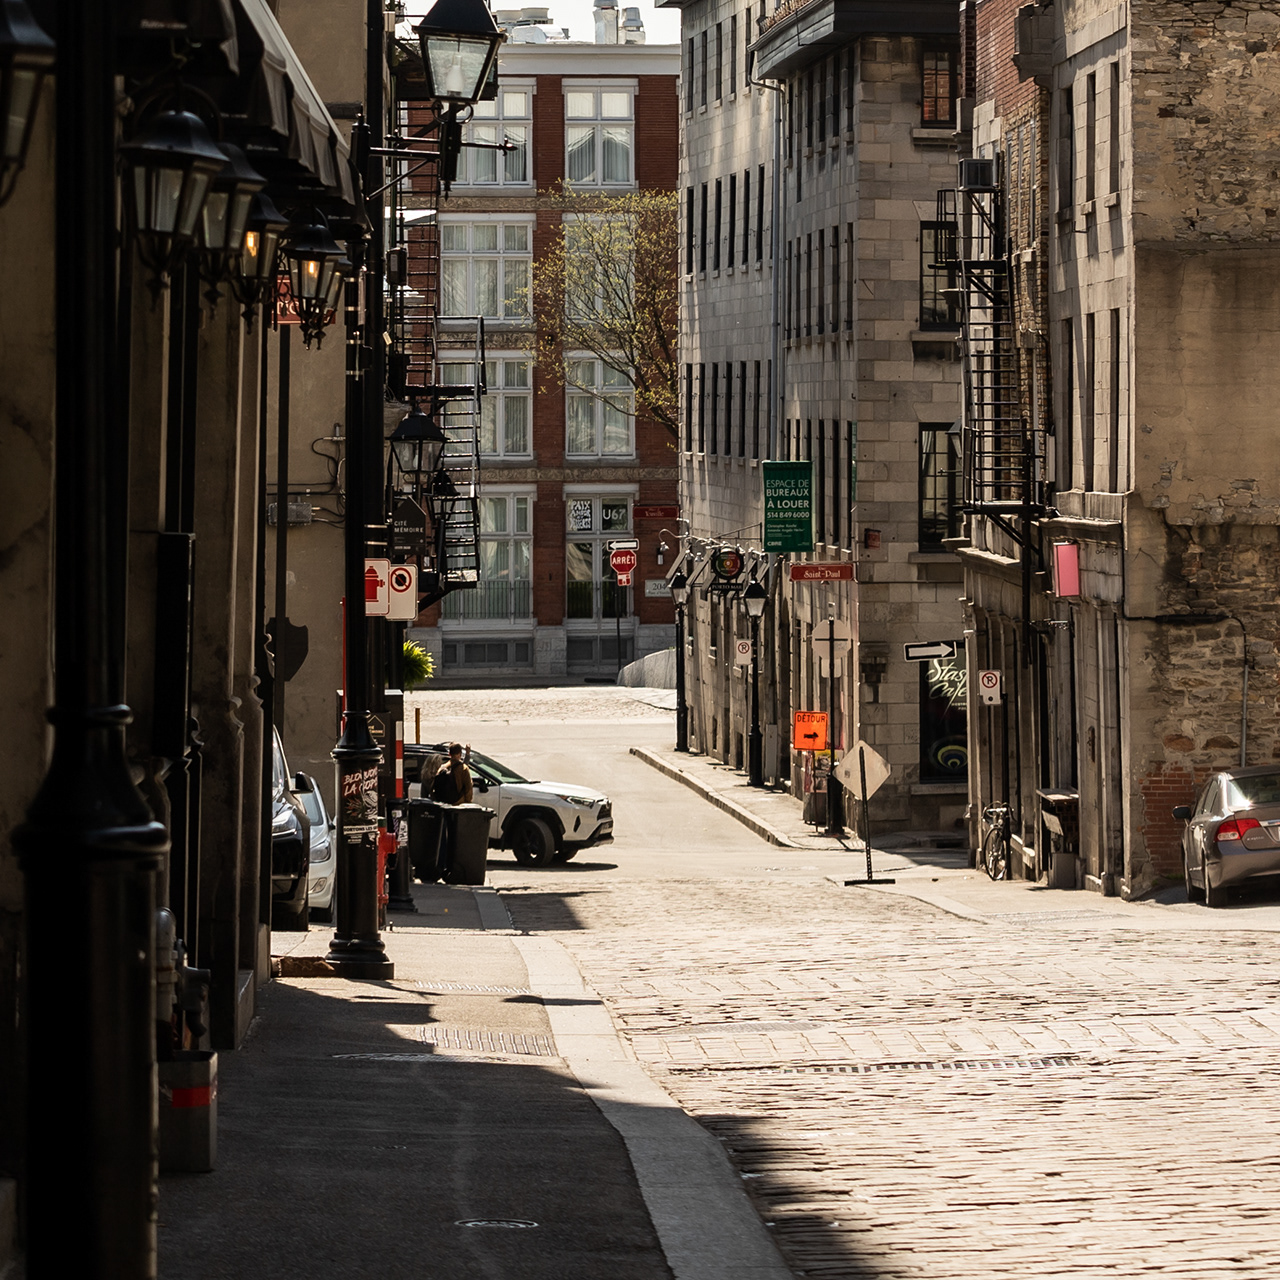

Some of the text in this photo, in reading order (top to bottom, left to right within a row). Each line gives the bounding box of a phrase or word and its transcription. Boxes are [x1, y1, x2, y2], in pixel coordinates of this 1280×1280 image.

[767, 498, 809, 508] À LOUER
[612, 556, 635, 565] ARRÊT
[803, 569, 841, 578] Saint-Paul
[926, 659, 968, 683] Stas
[797, 713, 826, 723] DÉTOUR
